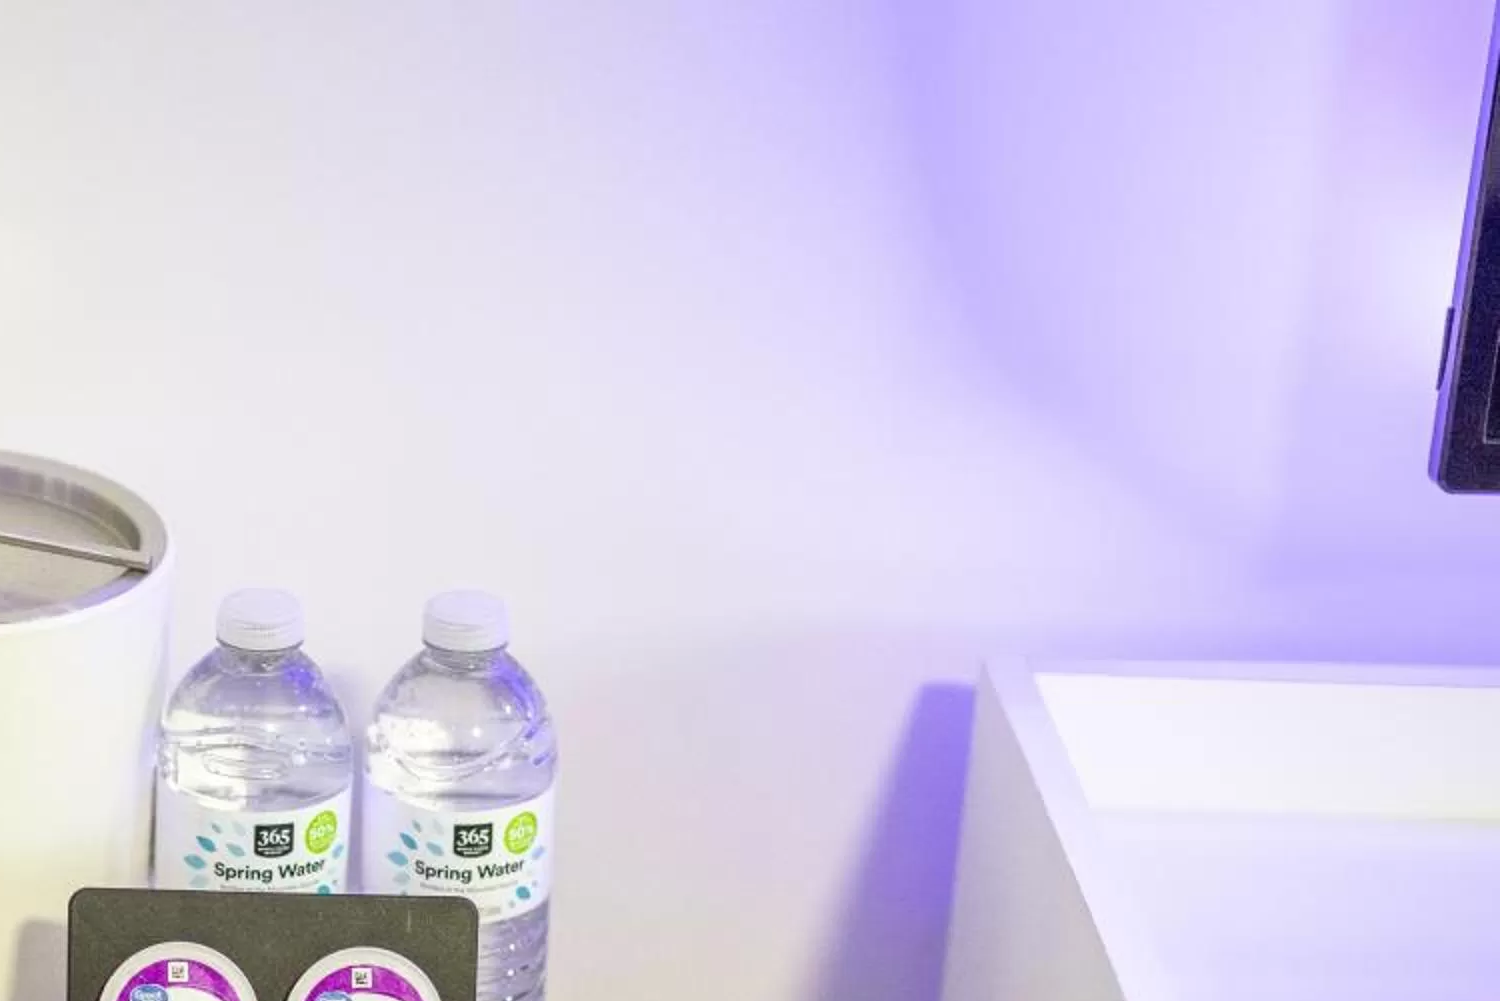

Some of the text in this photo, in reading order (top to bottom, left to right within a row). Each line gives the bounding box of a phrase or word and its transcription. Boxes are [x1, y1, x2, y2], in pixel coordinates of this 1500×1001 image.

[257, 828, 290, 846] 365
[457, 828, 489, 846] 365
[214, 859, 325, 883] Spring Water
[415, 860, 525, 884] Spring Water
